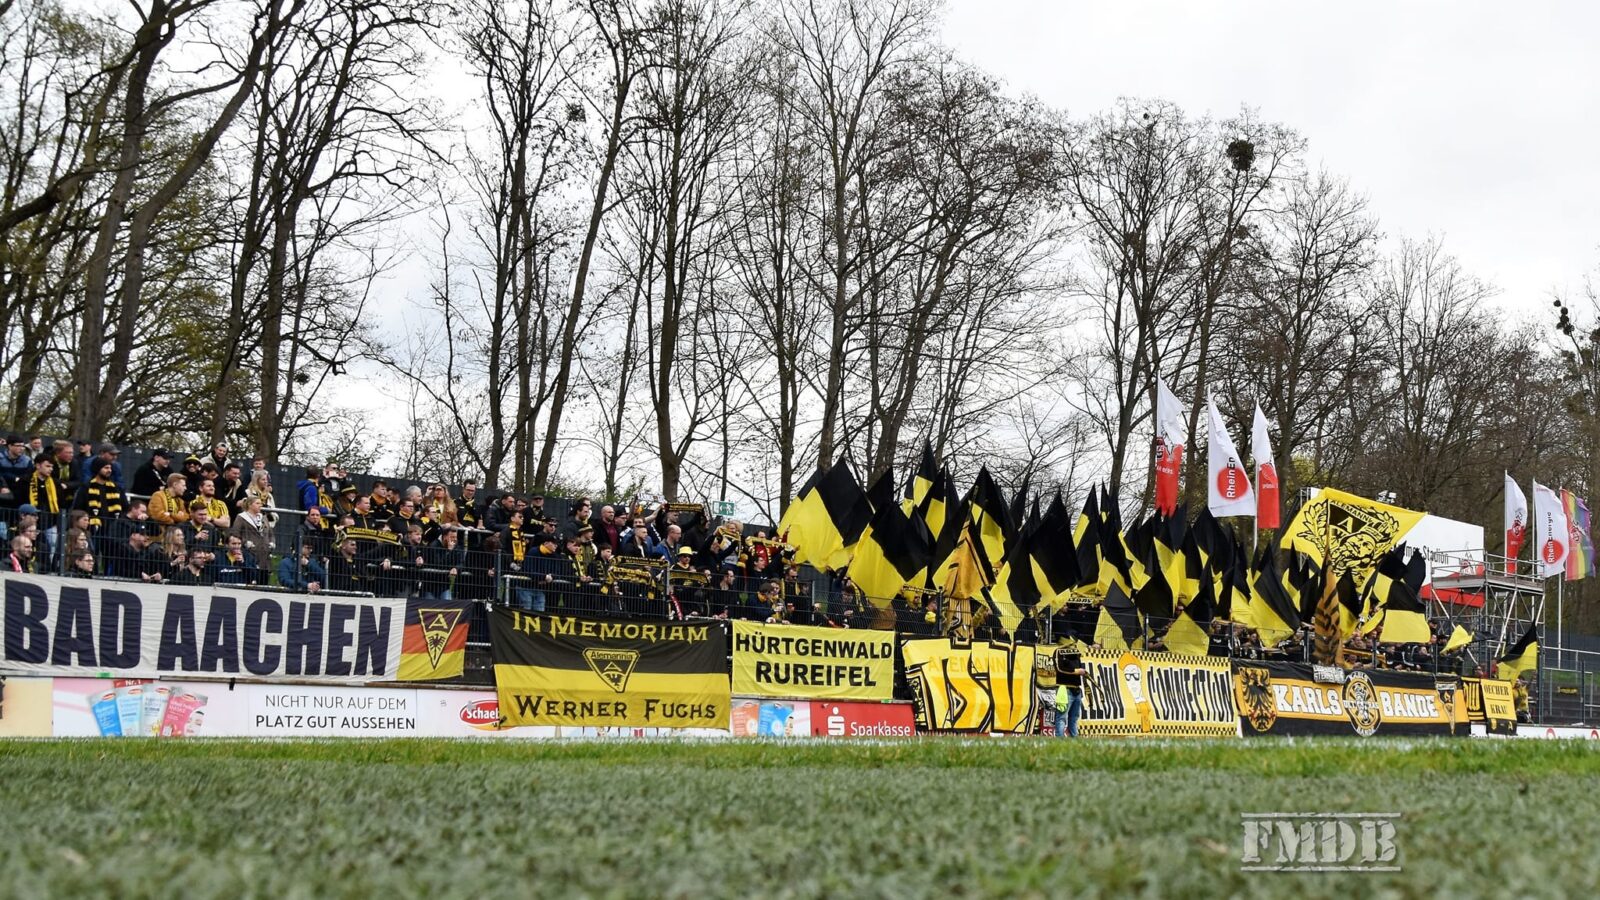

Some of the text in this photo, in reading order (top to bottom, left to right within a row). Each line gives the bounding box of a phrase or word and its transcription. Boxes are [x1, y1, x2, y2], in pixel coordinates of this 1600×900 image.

[4, 579, 391, 677] BAD AACHEN
[549, 615, 709, 645] MEMORIAM
[590, 651, 633, 660] Alemannia
[735, 631, 893, 660] HÜRTGENWALD
[755, 661, 877, 687] RUREIFEL
[265, 695, 406, 710] NICHT NUR AUF DEM
[514, 695, 716, 721] WERNER FUCHS
[1272, 684, 1343, 716] KARLS
[1379, 691, 1439, 718] BANDE
[256, 715, 415, 729] PLATZ GUT AUSSEHEN
[850, 721, 911, 737] Sparkasse
